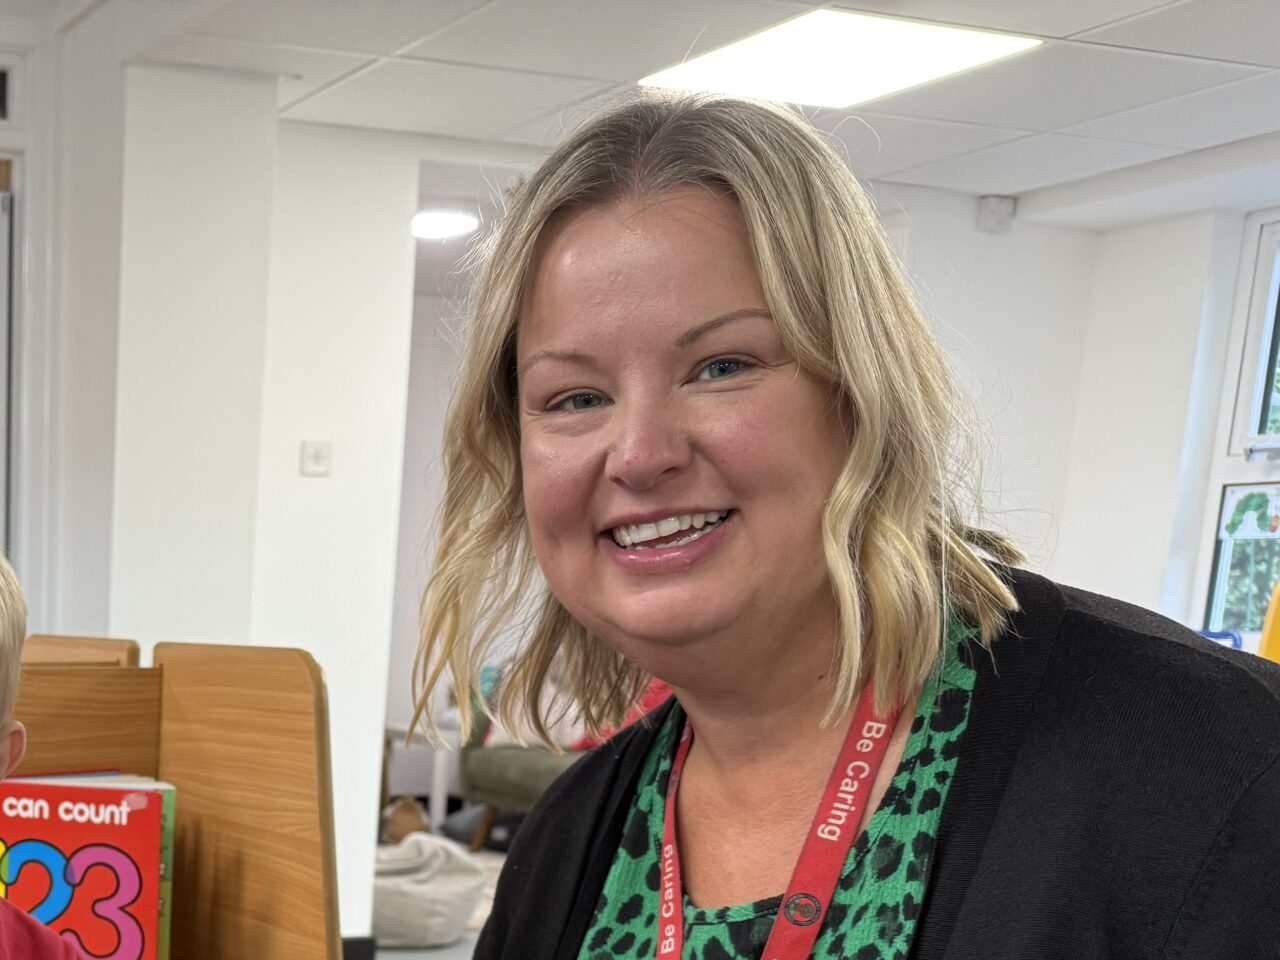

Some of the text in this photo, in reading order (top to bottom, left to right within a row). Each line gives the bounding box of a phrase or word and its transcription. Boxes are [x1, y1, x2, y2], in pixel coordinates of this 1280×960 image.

[2, 797, 50, 819] can
[58, 799, 130, 825] count
[817, 720, 888, 841] Be Caring
[660, 844, 676, 955] Be Caring
